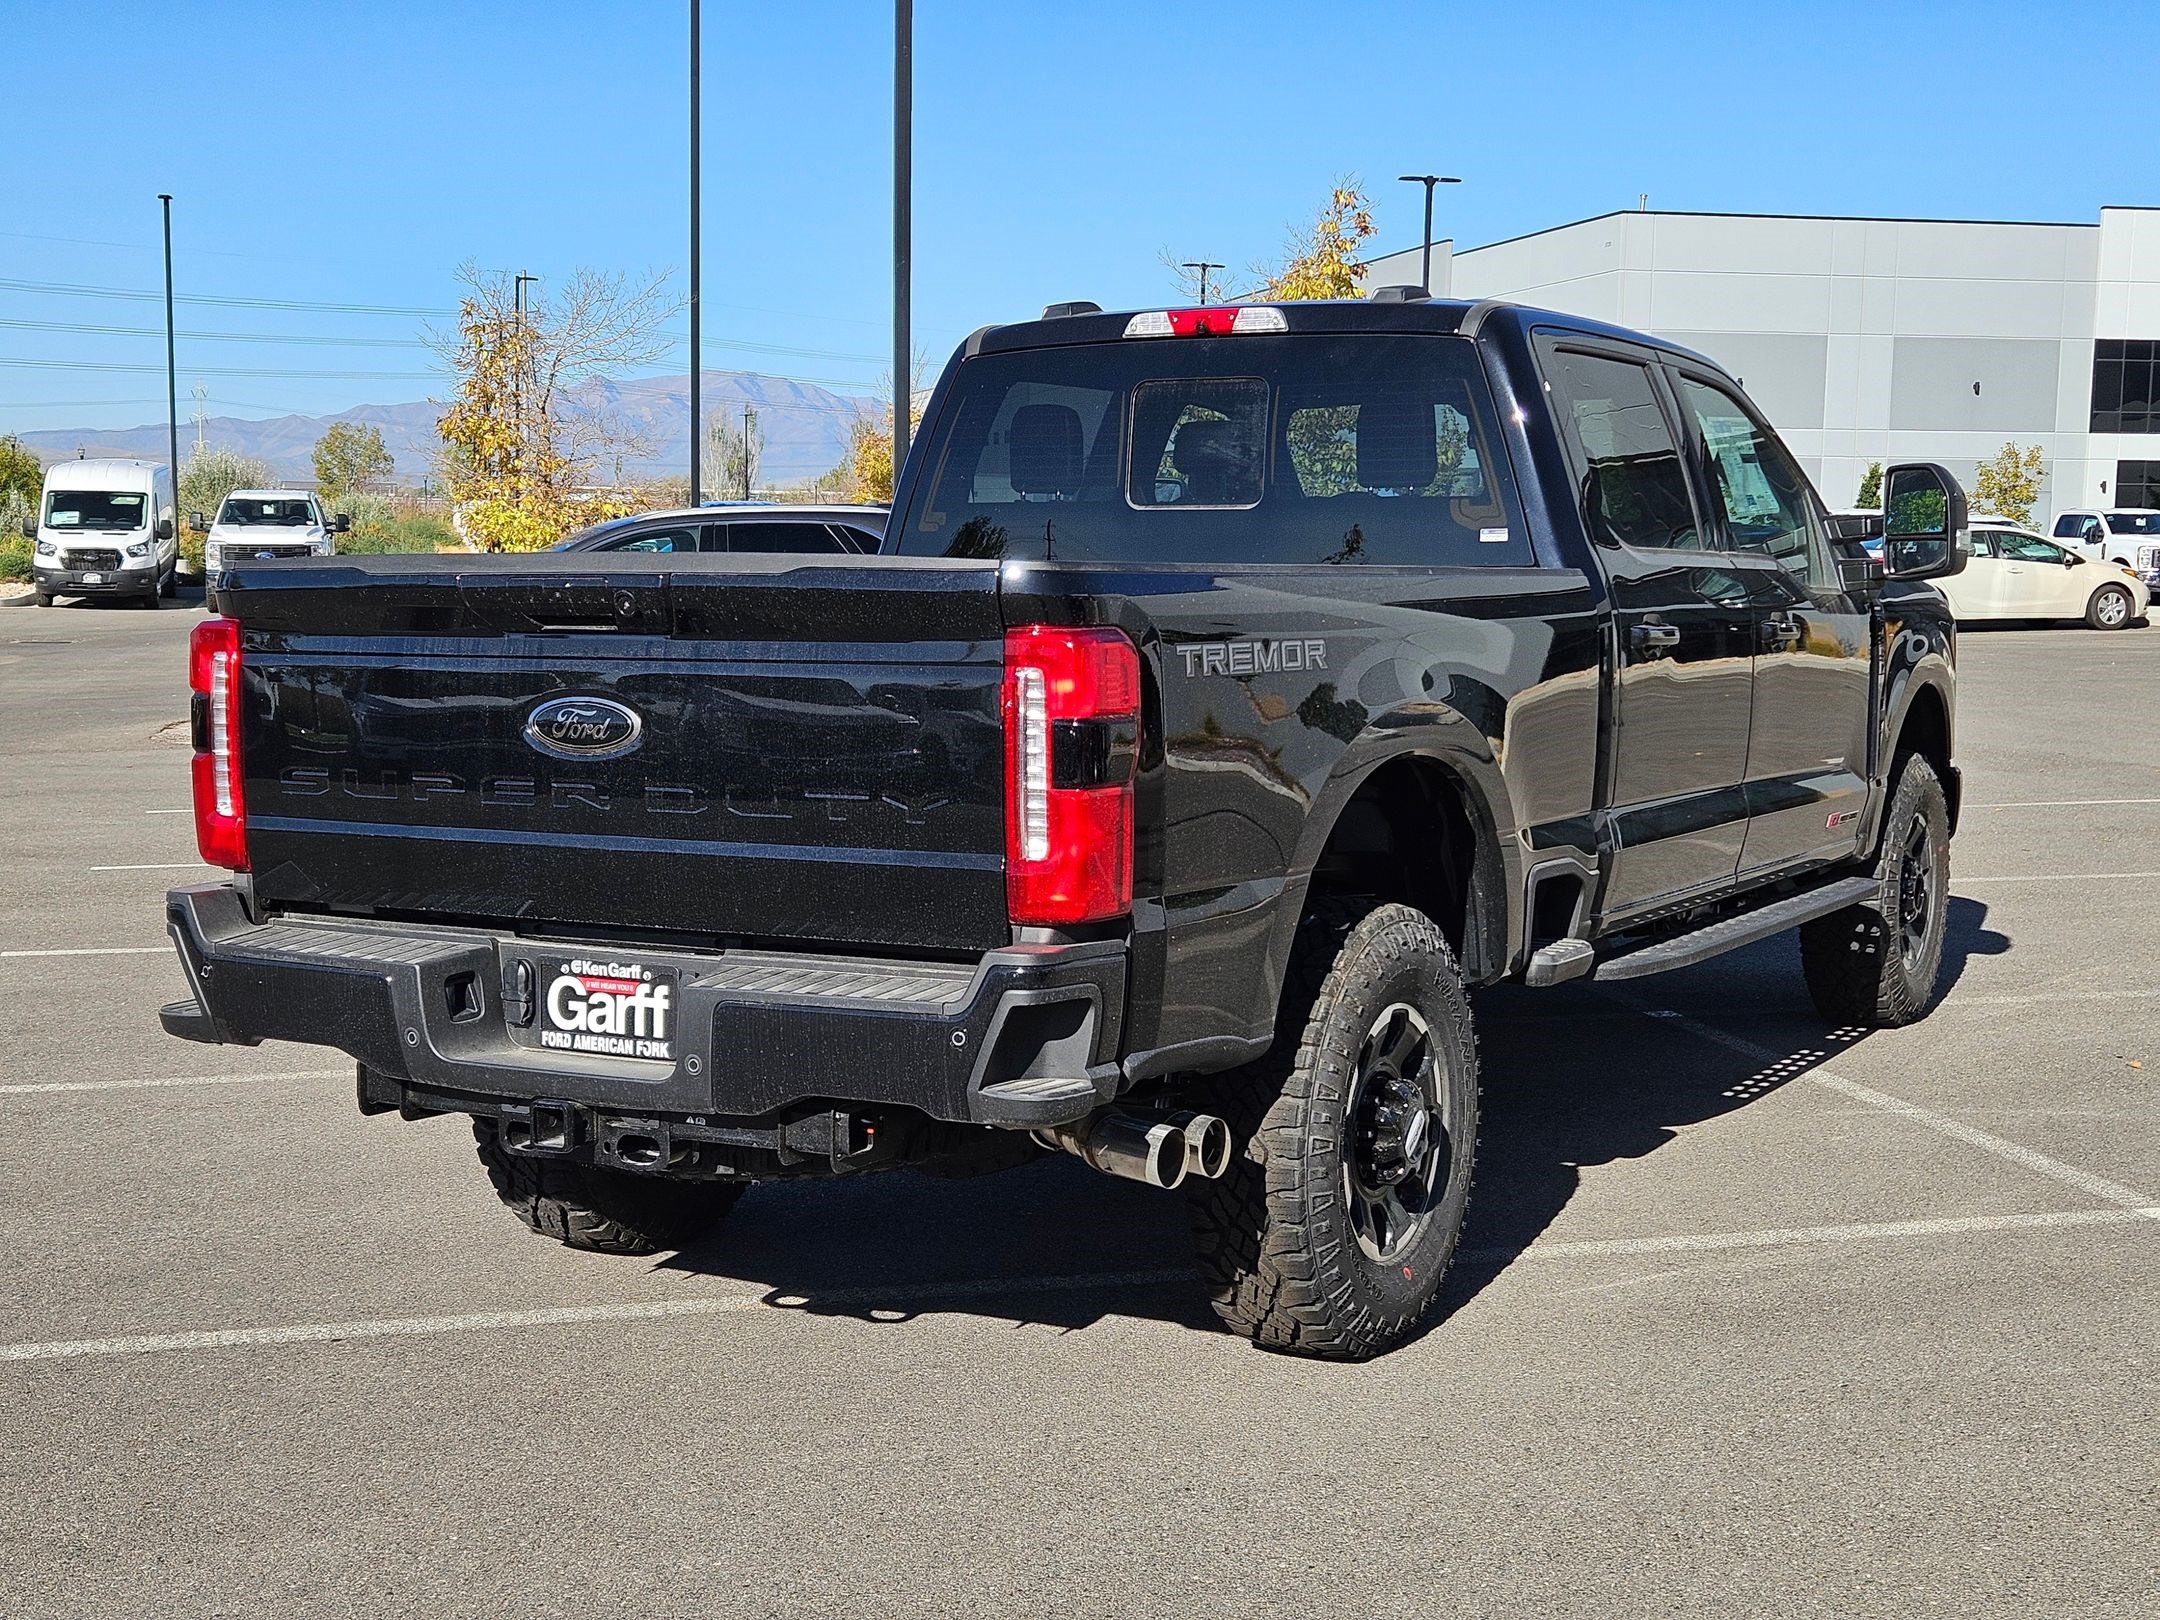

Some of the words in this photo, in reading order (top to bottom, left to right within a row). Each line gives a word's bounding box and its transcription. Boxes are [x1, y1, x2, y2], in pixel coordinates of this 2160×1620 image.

[1175, 638, 1328, 677] TREMOR
[551, 708, 612, 740] Ford
[279, 767, 611, 811] SUPER
[644, 777, 960, 825] DUTY
[582, 962, 607, 977] Ken
[608, 964, 642, 980] Garff
[601, 982, 617, 990] HEAR
[547, 975, 670, 1039] Garff
[541, 1031, 572, 1048] FORD
[574, 1034, 634, 1056] AMERICAN
[635, 1041, 671, 1059] FORK
